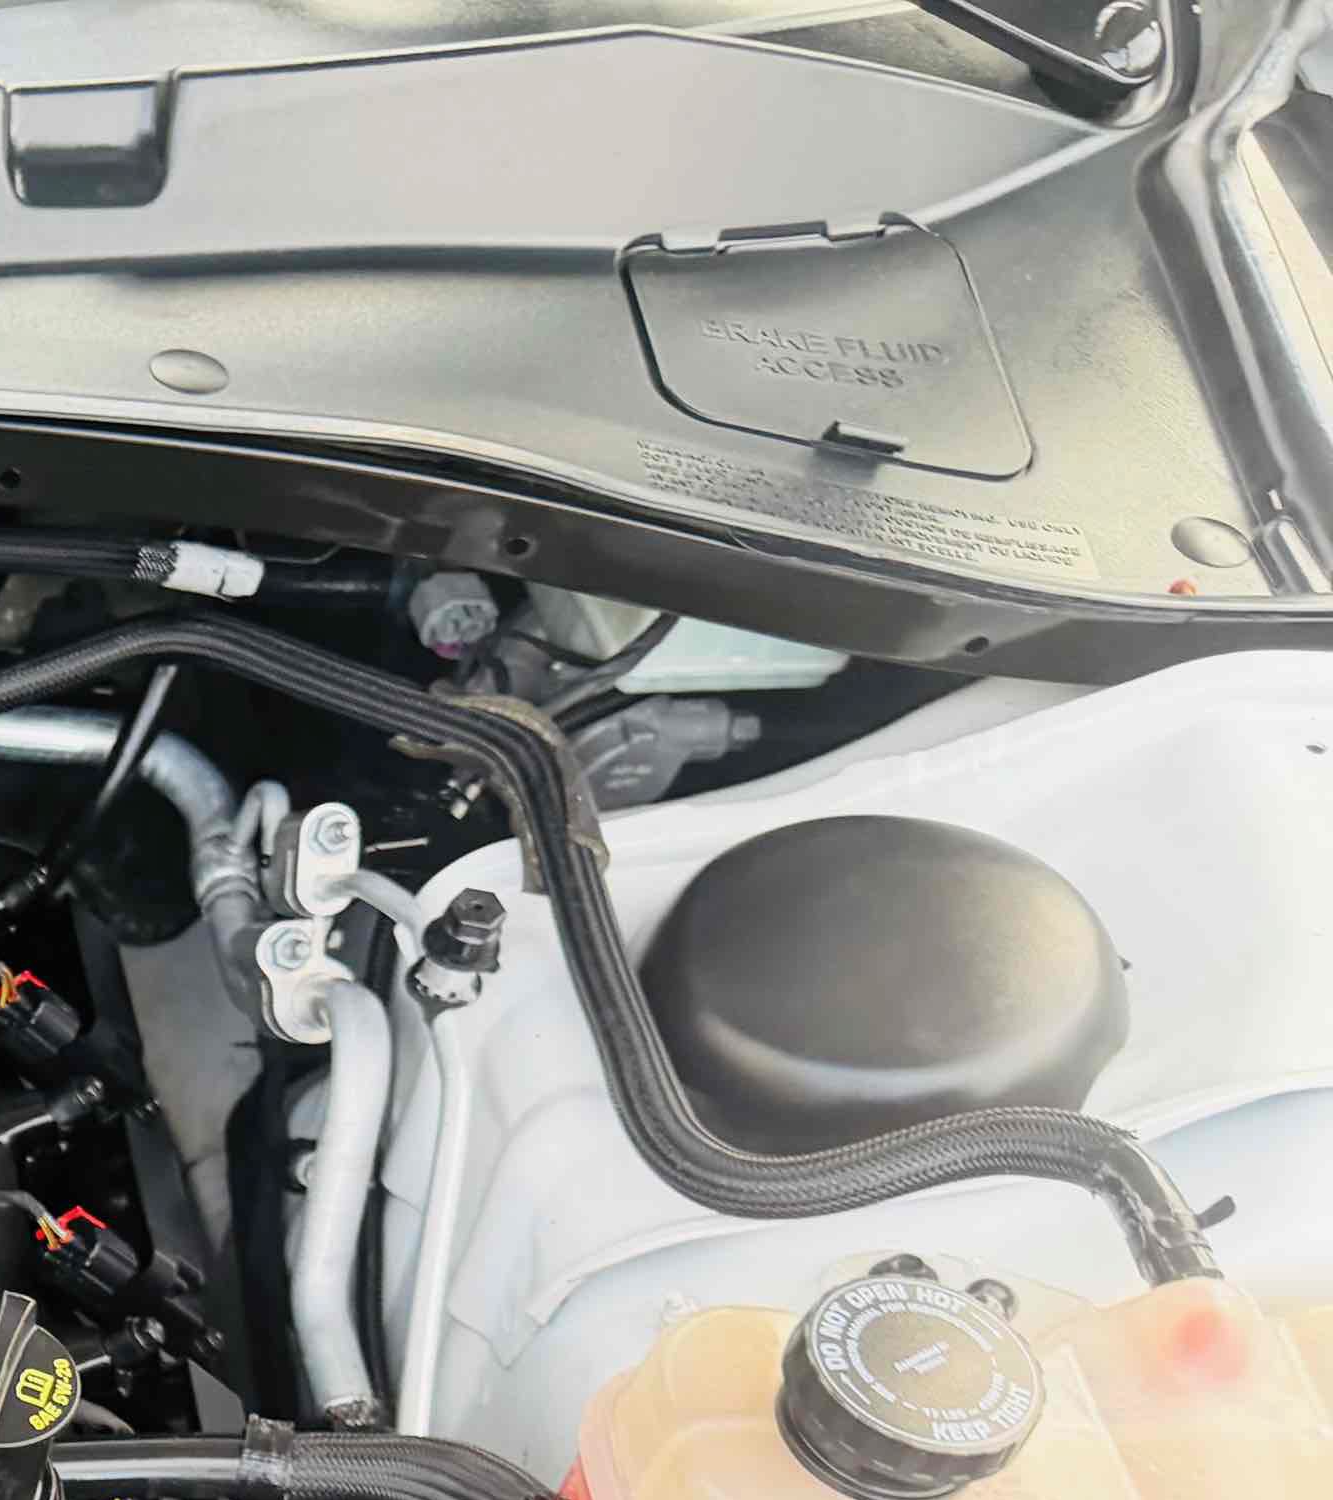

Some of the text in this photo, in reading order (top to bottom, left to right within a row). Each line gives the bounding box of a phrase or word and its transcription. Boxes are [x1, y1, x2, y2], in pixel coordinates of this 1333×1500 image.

[699, 318, 946, 367] BRAKE FLUID
[753, 353, 908, 390] ACCESS
[845, 1282, 910, 1309] OPEN
[916, 1287, 967, 1314] HOT
[820, 1301, 851, 1339] NOT
[820, 1341, 849, 1371] DO
[28, 1358, 75, 1432] SAE 5W-20
[932, 1422, 991, 1442] KEEP
[989, 1382, 1032, 1429] TIGHT
